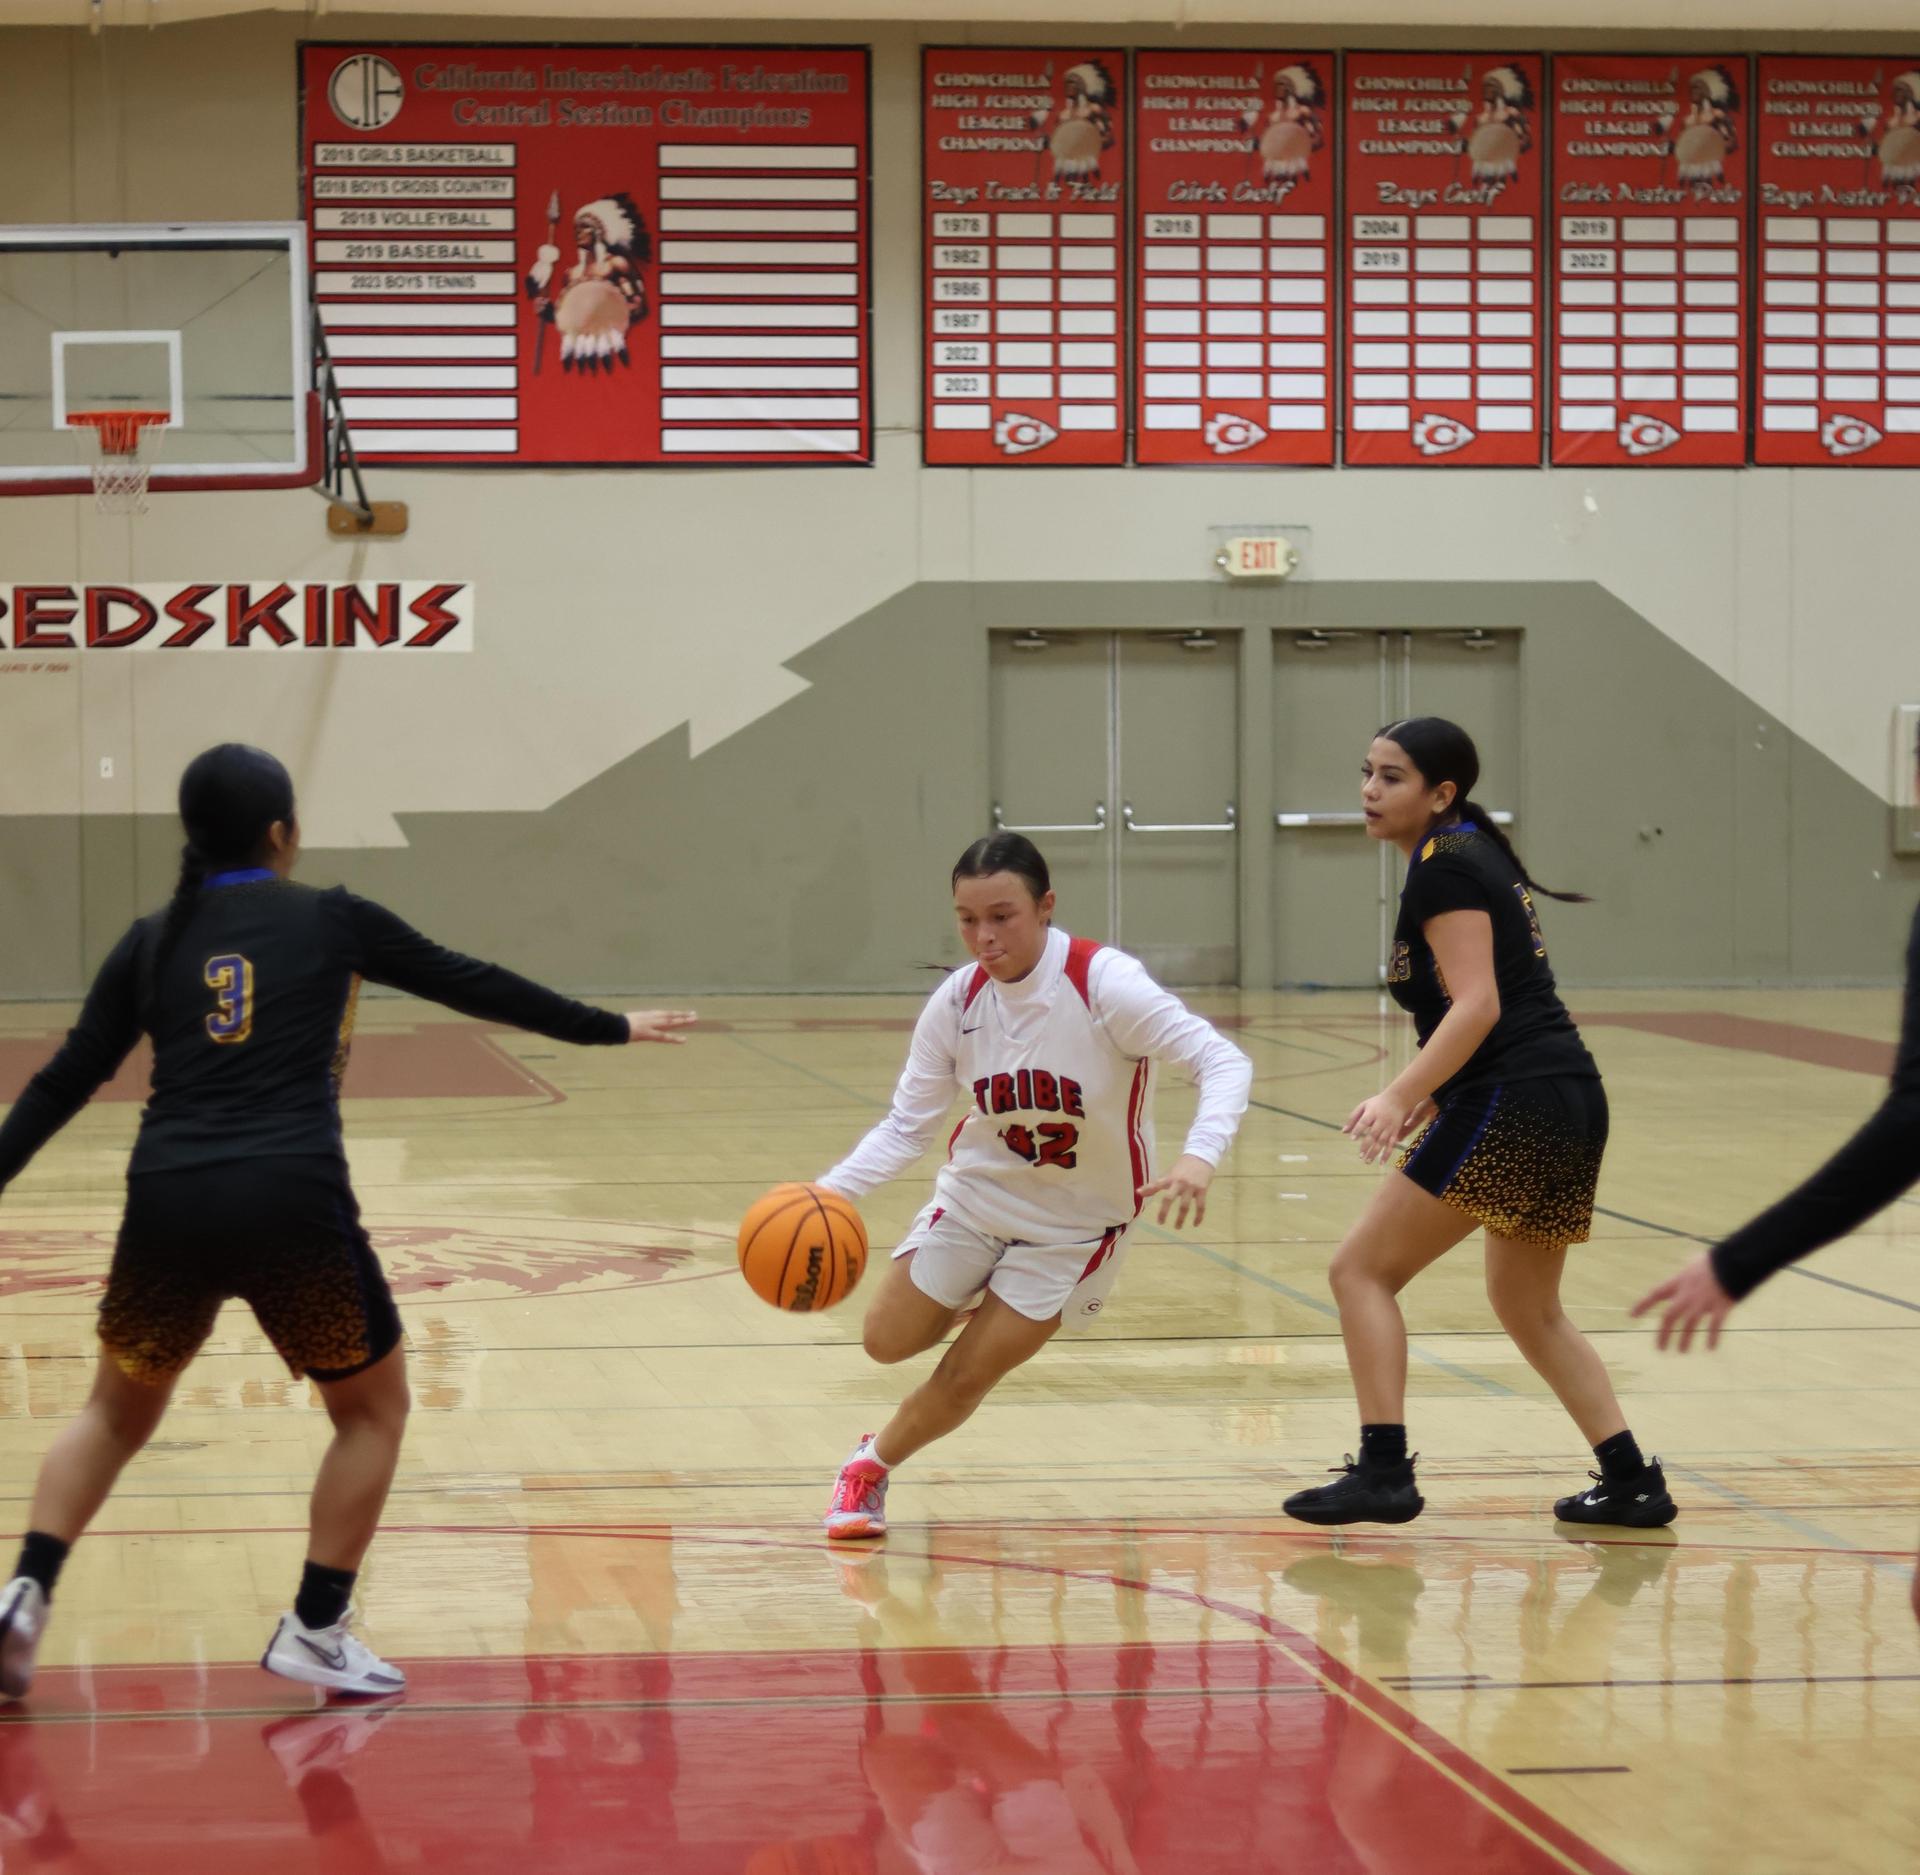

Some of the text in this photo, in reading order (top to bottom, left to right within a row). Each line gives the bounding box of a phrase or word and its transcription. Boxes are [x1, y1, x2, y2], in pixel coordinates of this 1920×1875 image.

[413, 63, 849, 93] California Interscholastic Federation
[934, 73, 1051, 87] CHOWCHILLA
[1145, 75, 1260, 89] CHOWCHILLA
[1355, 76, 1468, 90] CHOWCHILLA
[1562, 79, 1675, 92] CHOWCHILLA
[1768, 80, 1879, 95] CHOWCHILLA
[932, 95, 979, 108] HIGH
[1143, 97, 1189, 110] HIGH
[1352, 98, 1398, 111] HIGH
[1560, 100, 1605, 113] HIGH
[1765, 101, 1810, 115] HIGH
[452, 99, 812, 132] Central Section Champions
[958, 116, 1025, 130] LEAGUE
[1168, 117, 1235, 131] LEAGUE
[1377, 119, 1444, 133] LEAGUE
[1585, 121, 1650, 135] LEAGUE
[1790, 122, 1854, 136] LEAGUE
[321, 148, 504, 162] 2018 GIRLS BASKETBALL
[351, 179, 388, 194] BOYS
[392, 180, 440, 194] CROSS
[443, 180, 508, 194] COUNTRY
[929, 180, 979, 205] Boys
[985, 181, 1041, 201] Track
[1066, 181, 1120, 201] Field
[1167, 180, 1296, 206] Girls Golf
[1560, 181, 1612, 202] Girls
[1376, 181, 1506, 208] Boys Golf
[1760, 182, 1814, 209] Boys
[340, 211, 491, 226] 2018 VOLLEYBALL
[1361, 220, 1399, 234] 2004
[345, 244, 485, 259] 2019 BASEBALL
[385, 275, 424, 289] BOYS
[427, 275, 477, 289] TENNIS
[1242, 541, 1277, 569] EXIT
[0, 583, 467, 648] EDSKINS
[204, 953, 254, 1044] 3
[973, 1068, 1085, 1120] TRIBE
